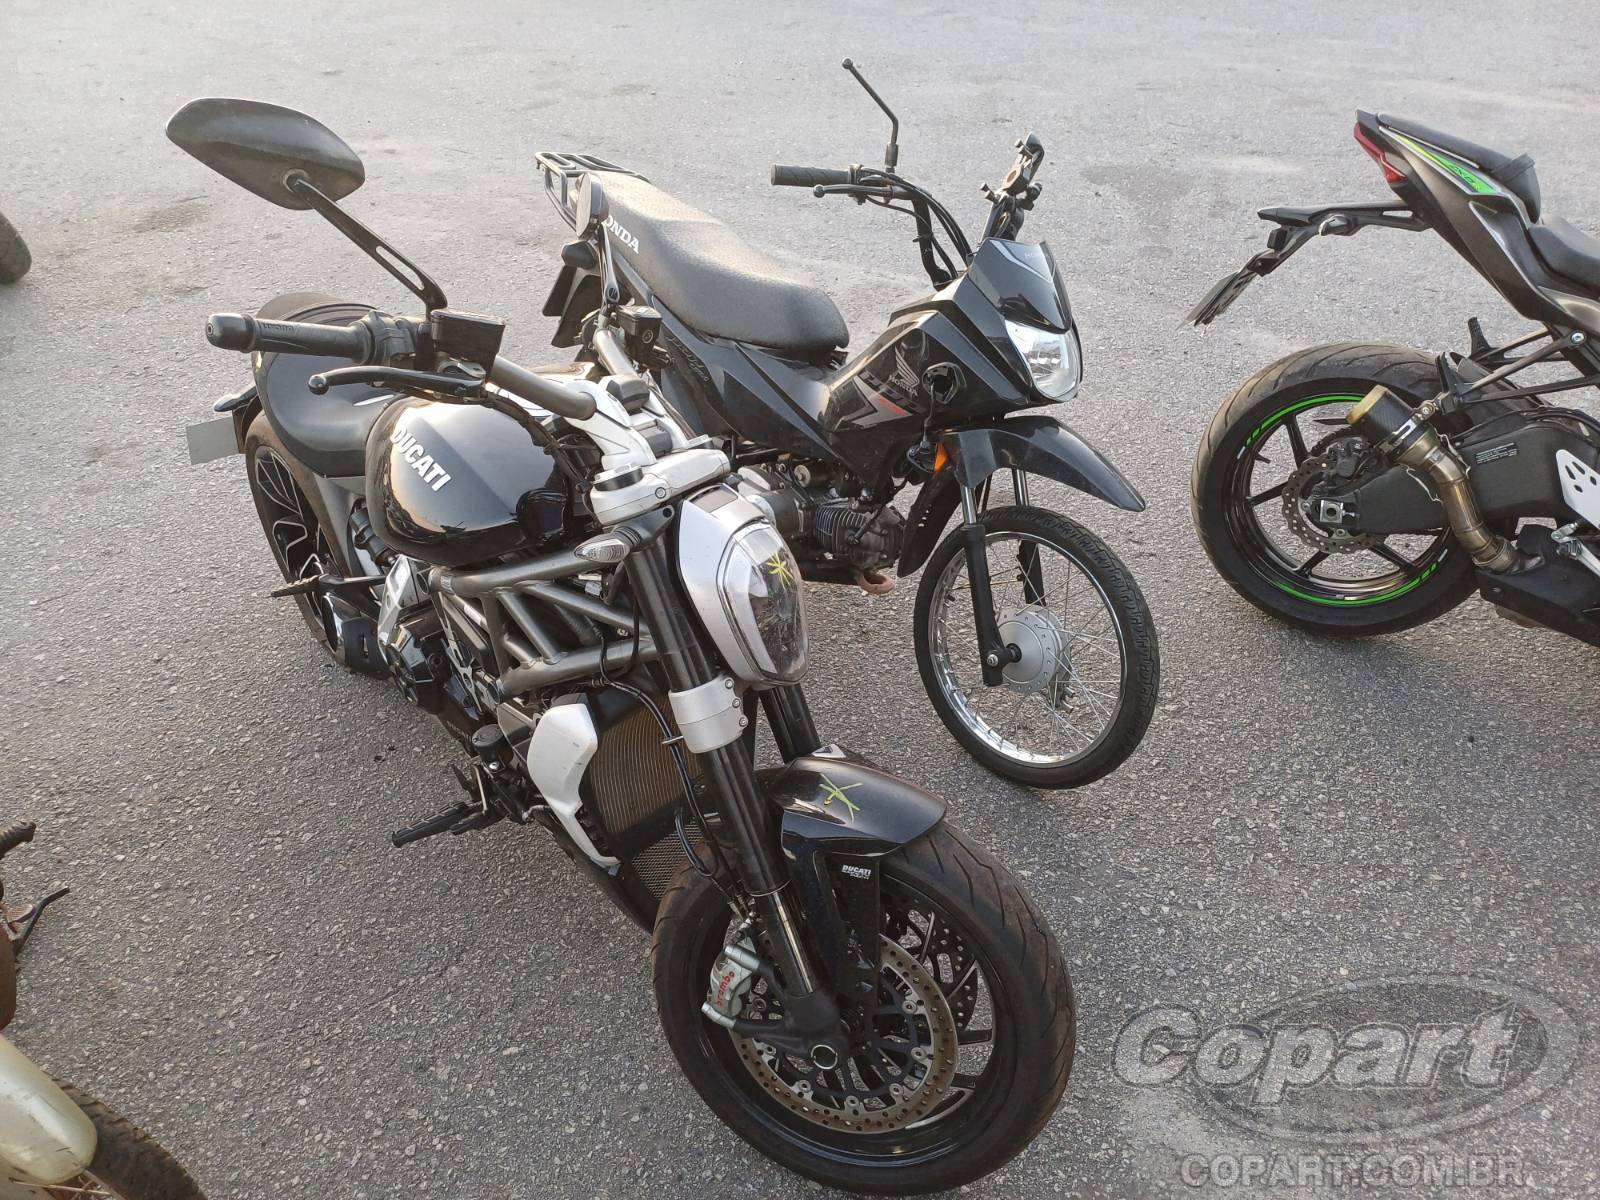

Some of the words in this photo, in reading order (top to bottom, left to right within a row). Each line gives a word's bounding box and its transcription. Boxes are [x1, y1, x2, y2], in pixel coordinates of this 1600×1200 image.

[602, 214, 640, 254] ONDA
[889, 374, 919, 397] HONDA
[390, 425, 452, 492] DUCATI
[717, 971, 735, 1008] brembo
